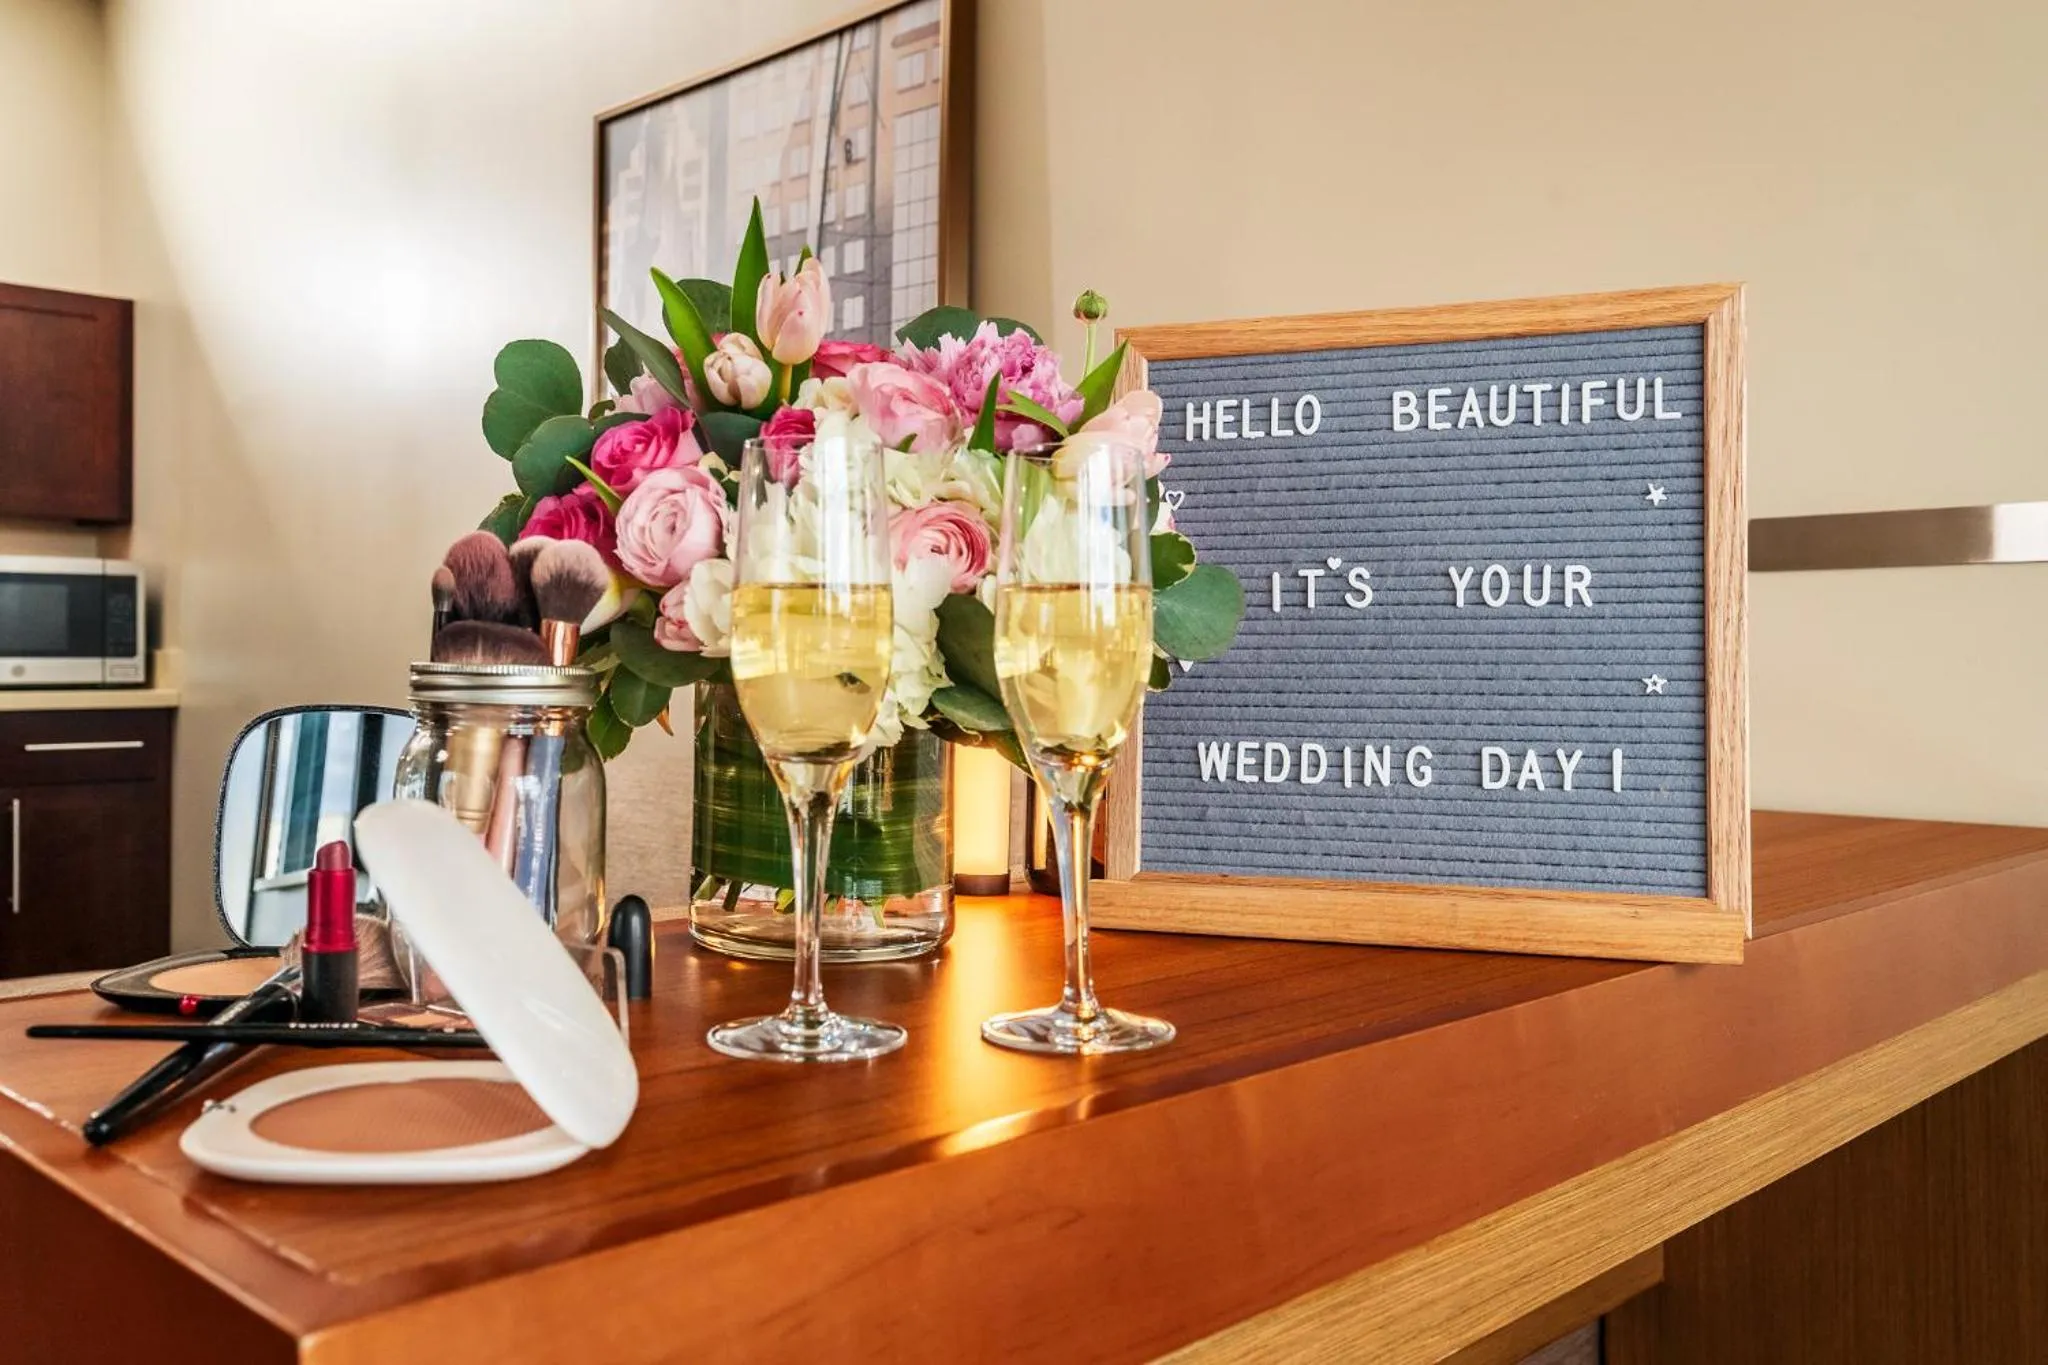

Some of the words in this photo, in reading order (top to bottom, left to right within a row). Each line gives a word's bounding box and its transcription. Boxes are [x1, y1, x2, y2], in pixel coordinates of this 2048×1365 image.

[1186, 394, 1323, 442] HELLO
[1392, 376, 1681, 432] BEAUTIFUL
[1448, 562, 1594, 608] YOUR
[1197, 740, 1434, 789] WEDDING
